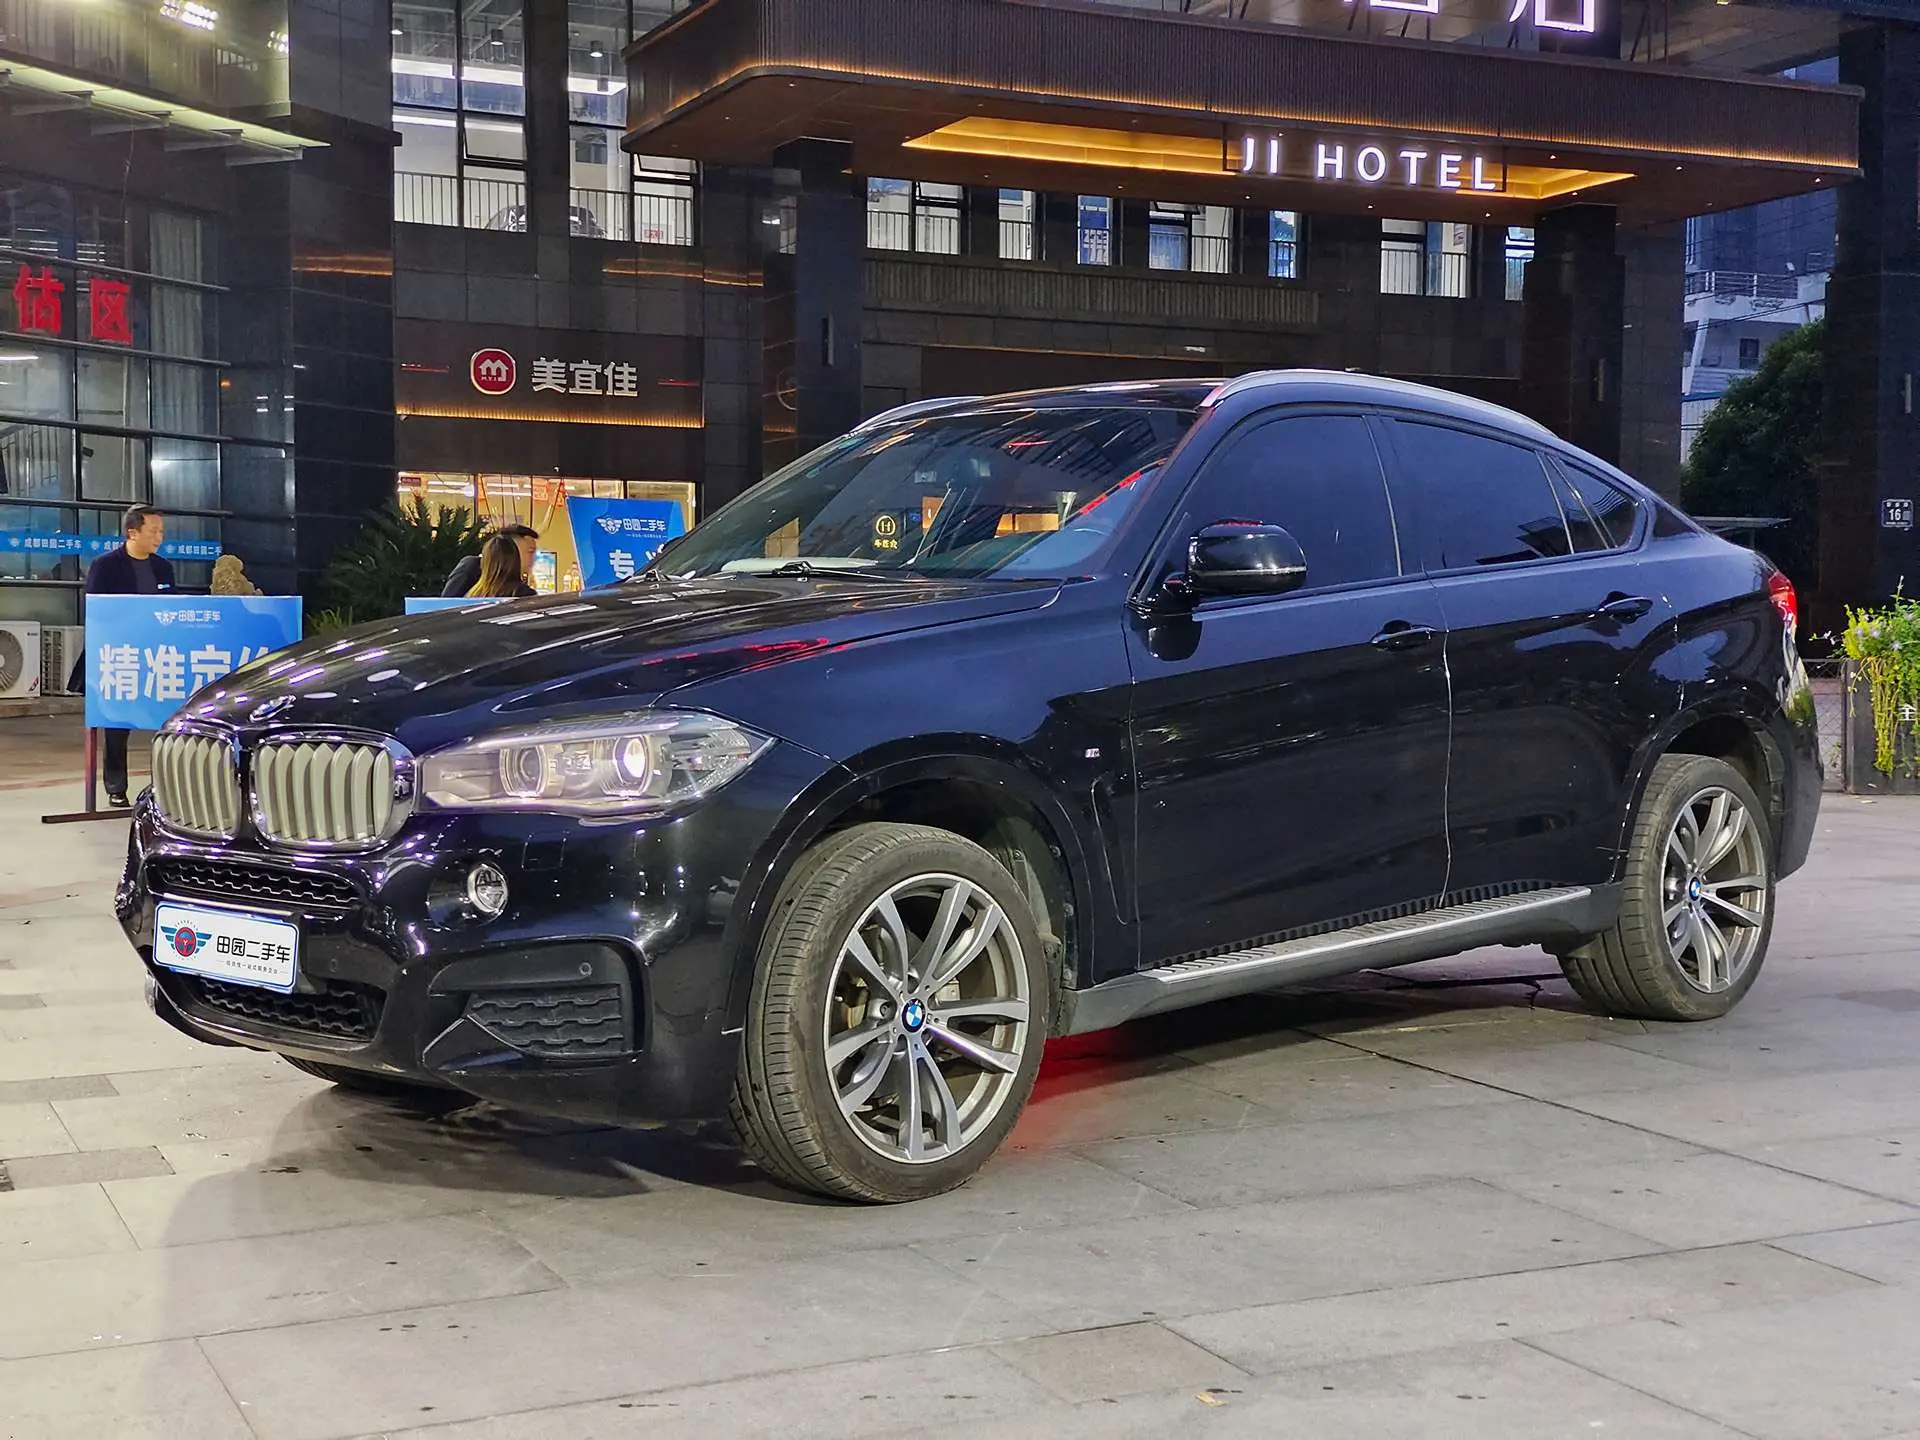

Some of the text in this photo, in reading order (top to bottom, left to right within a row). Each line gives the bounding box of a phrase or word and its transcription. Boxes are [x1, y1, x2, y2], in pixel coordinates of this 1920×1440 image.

[1316, 142, 1496, 191] HOTEL
[13, 263, 133, 345] 估区
[531, 356, 638, 397] 美宜佳
[178, 609, 221, 622] 田园二手车
[216, 935, 291, 964] 田园二手车
